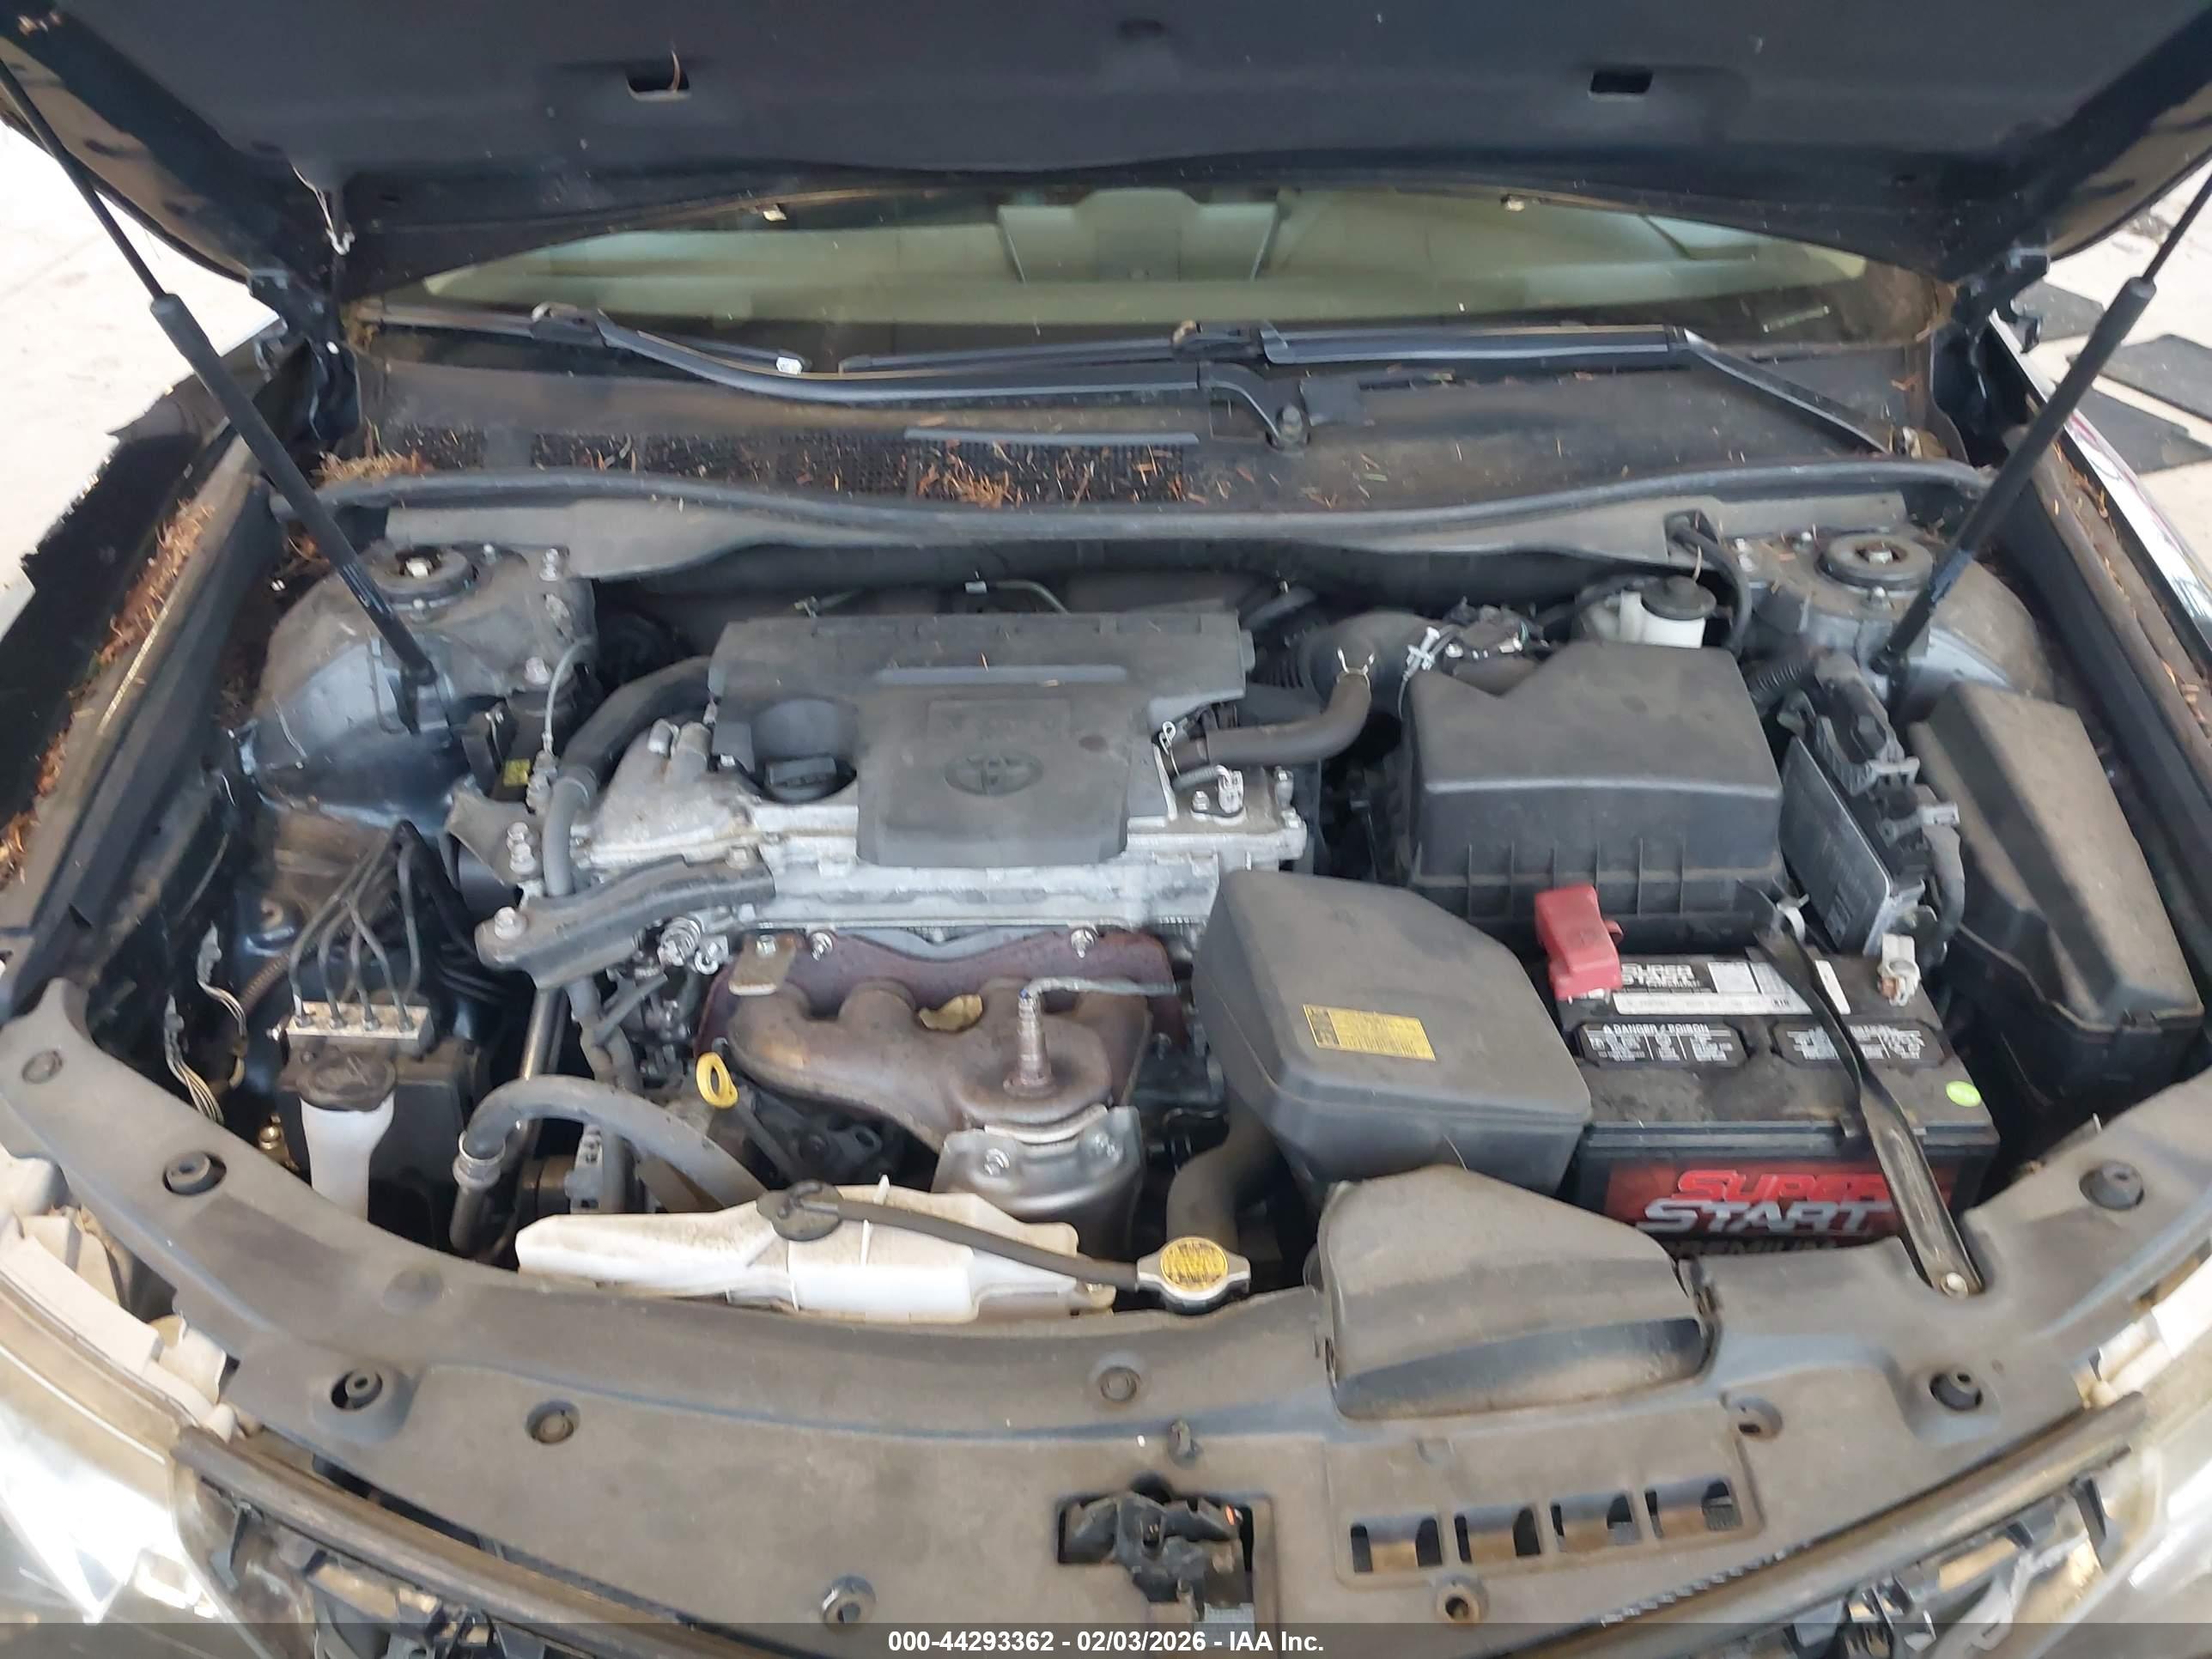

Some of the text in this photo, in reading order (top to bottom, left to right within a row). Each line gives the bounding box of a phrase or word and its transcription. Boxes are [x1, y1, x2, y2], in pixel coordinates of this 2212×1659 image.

[1613, 1024, 1658, 1035] DANGER
[1672, 1170, 1888, 1202] SUPER
[1636, 1199, 1893, 1234] START
